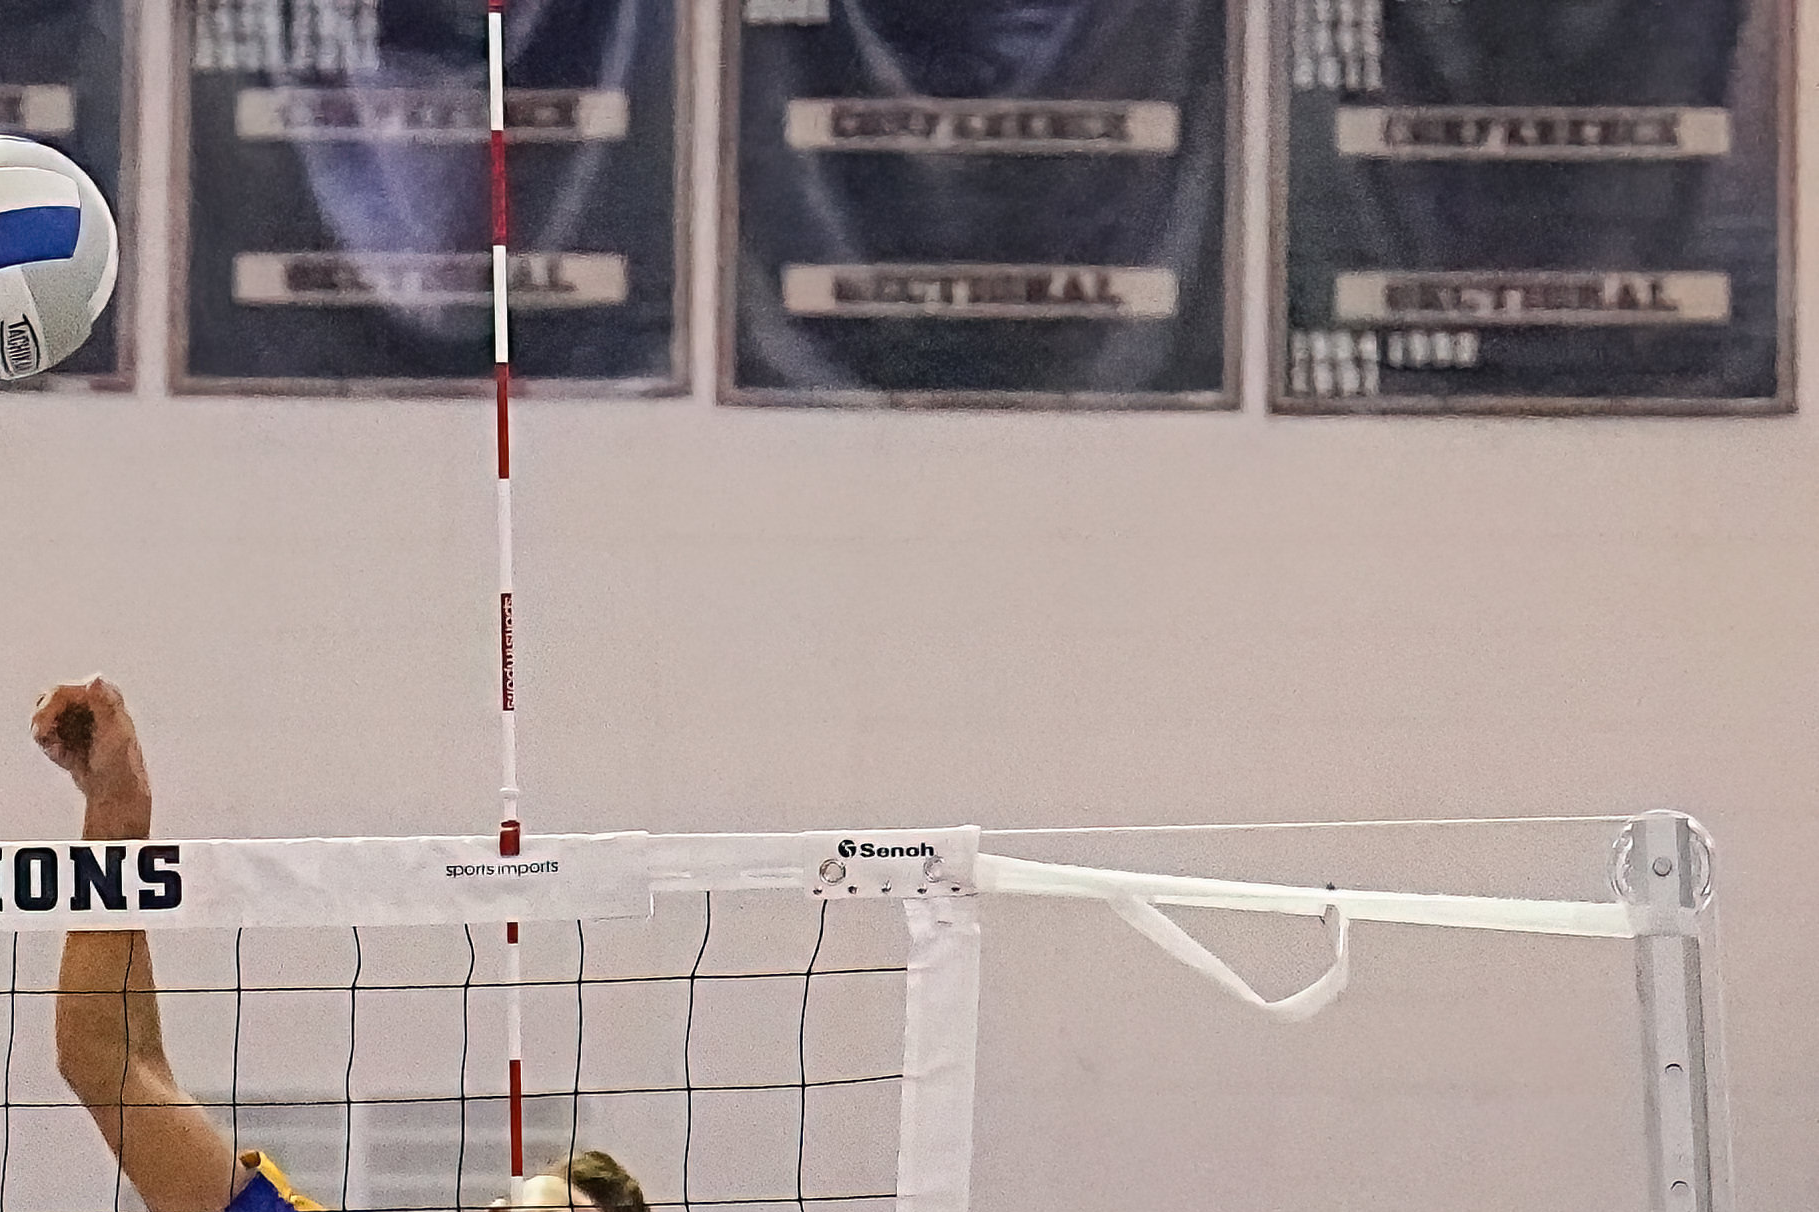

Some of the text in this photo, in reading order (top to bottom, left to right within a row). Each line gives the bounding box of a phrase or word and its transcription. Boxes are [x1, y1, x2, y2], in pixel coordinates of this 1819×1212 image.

[859, 841, 935, 858] Senoh
[445, 860, 559, 878] sports imports
